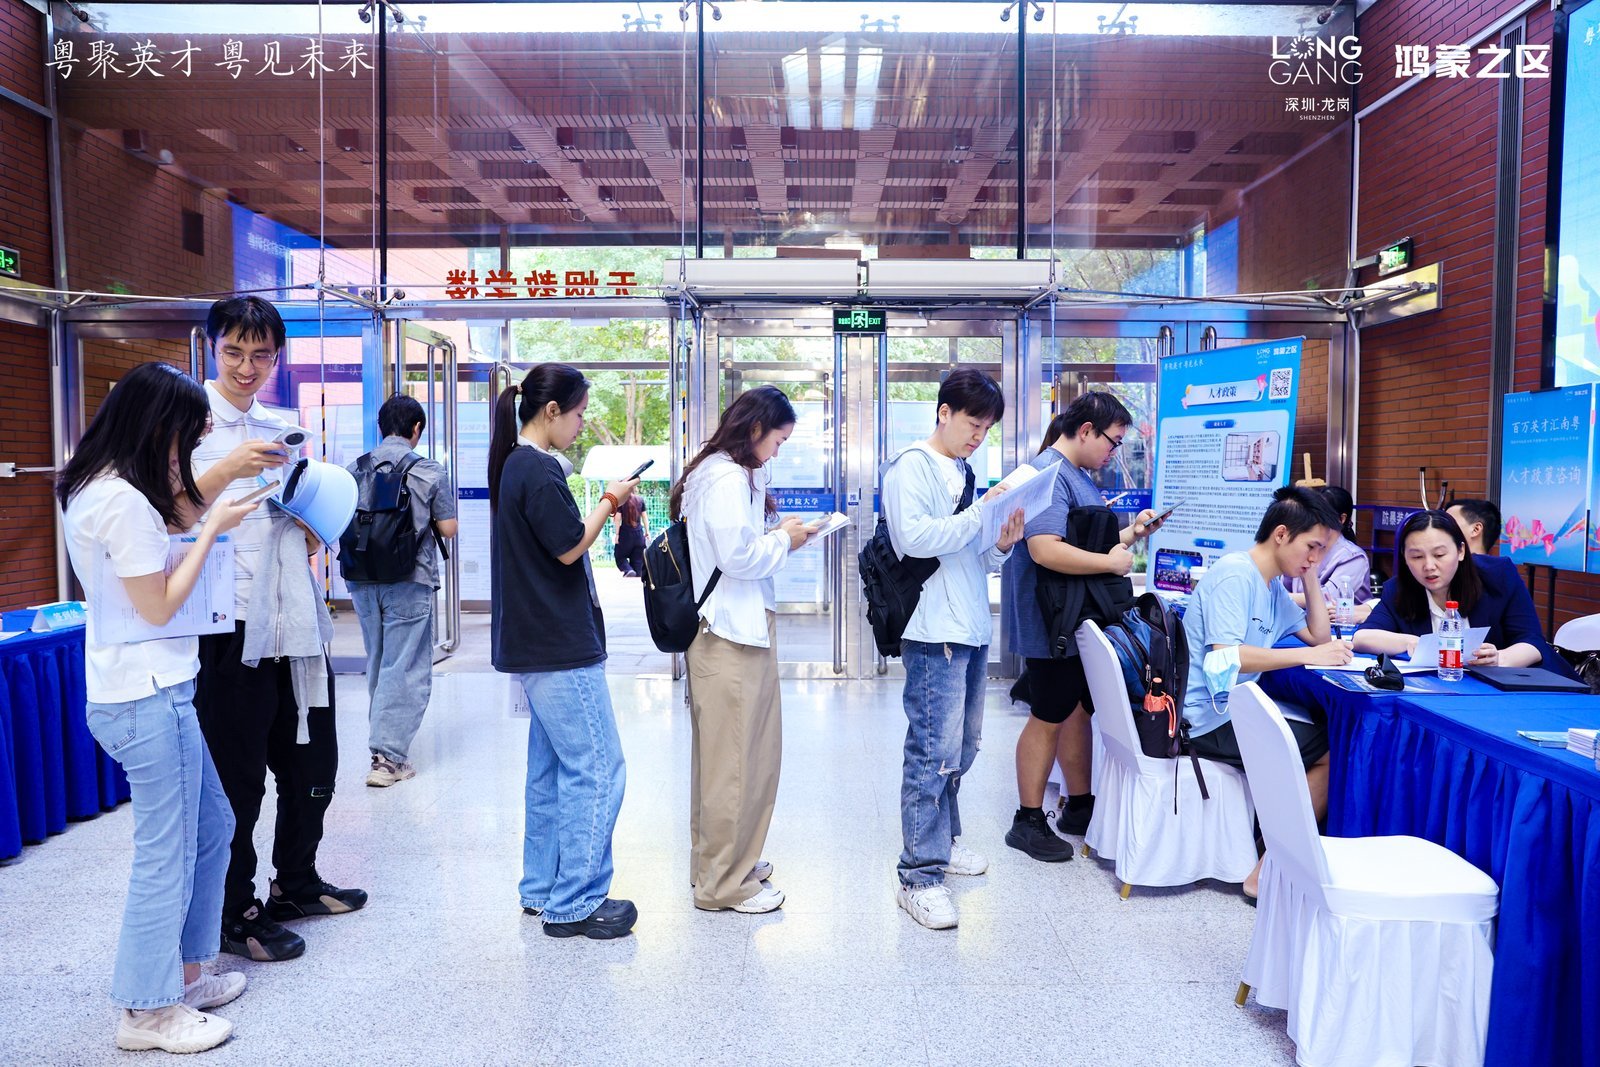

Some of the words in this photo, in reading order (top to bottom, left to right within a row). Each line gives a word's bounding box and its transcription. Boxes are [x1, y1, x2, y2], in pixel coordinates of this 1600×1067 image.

[868, 317, 882, 325] EXIT
[1208, 385, 1238, 400] 人才政策
[1511, 415, 1580, 434] 百万英才汇南粤
[1507, 466, 1581, 485] 人才政策咨询
